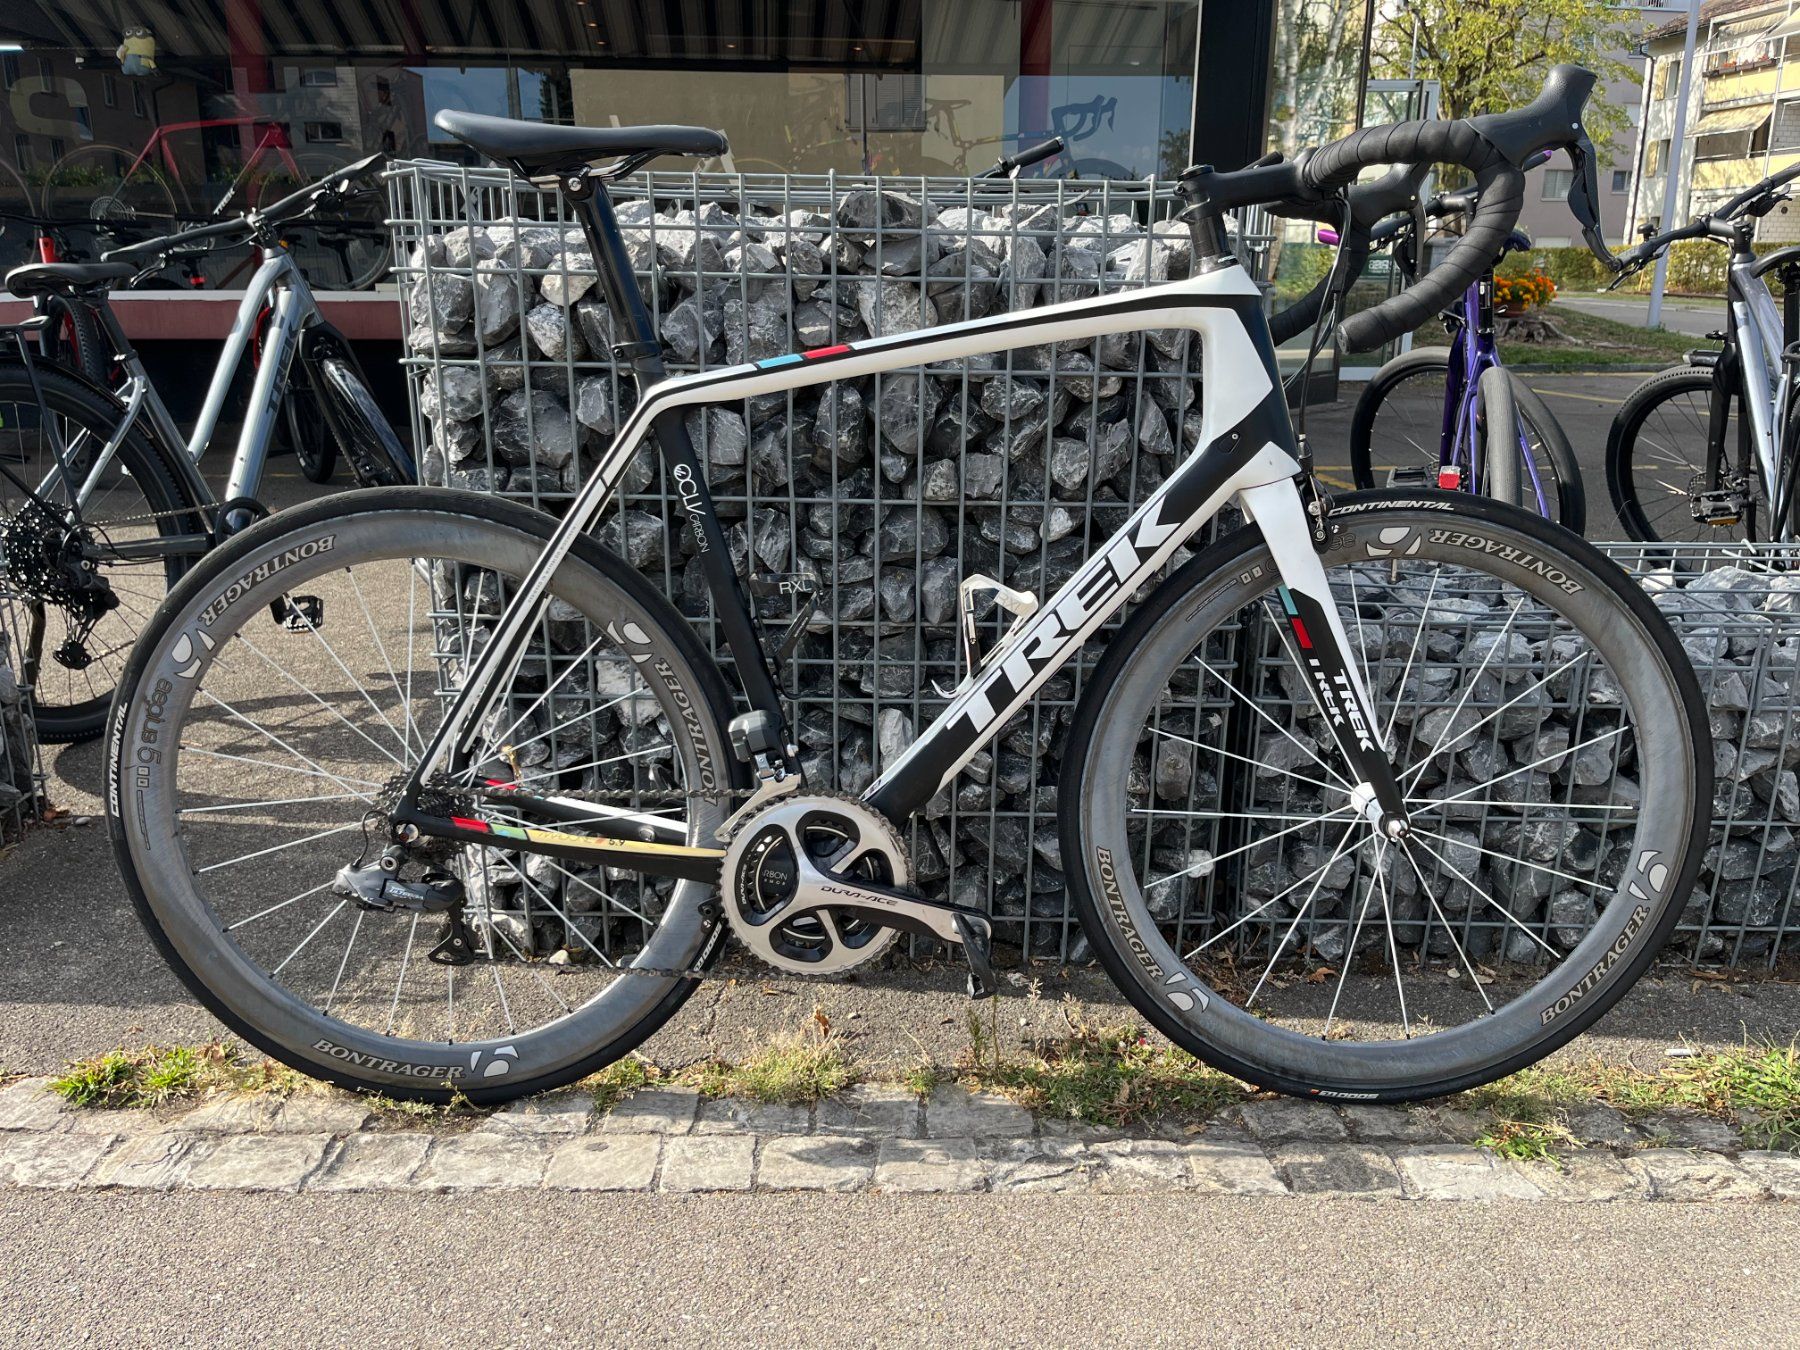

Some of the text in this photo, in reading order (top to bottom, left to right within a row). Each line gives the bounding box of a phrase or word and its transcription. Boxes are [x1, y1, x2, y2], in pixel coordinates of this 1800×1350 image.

[266, 320, 300, 414] TREK
[673, 463, 711, 553] OCLV CARBON
[1328, 500, 1455, 517] CONTINENTAL
[198, 533, 338, 627] BONTRAGER
[779, 580, 813, 595] RXL
[1428, 527, 1585, 597] BONTRAGER
[946, 495, 1181, 734] TREK
[140, 678, 173, 744] aeolus
[1334, 669, 1375, 752] TREK
[108, 702, 129, 818] CONTINENTAL
[762, 869, 788, 881] RBON
[820, 885, 899, 907] DURA-ACE
[1096, 845, 1165, 980] BONTRAGER
[1540, 904, 1651, 1028] BONTRAGER
[313, 1037, 465, 1080] BONTRAGER
